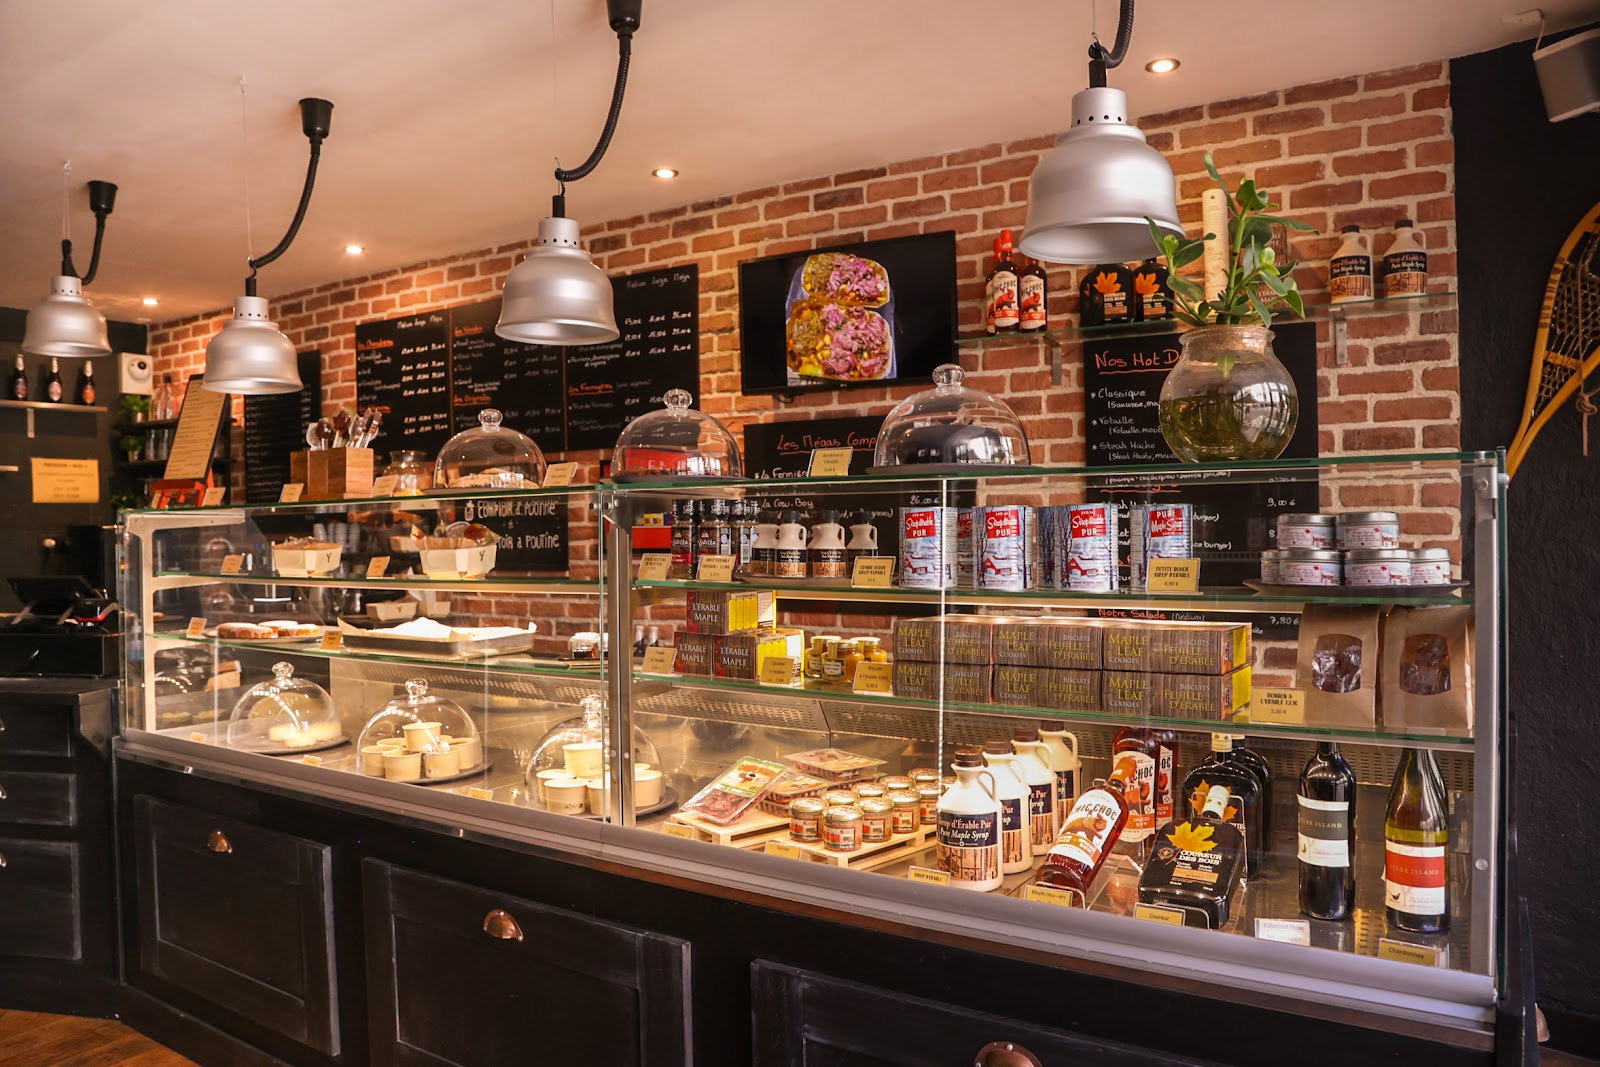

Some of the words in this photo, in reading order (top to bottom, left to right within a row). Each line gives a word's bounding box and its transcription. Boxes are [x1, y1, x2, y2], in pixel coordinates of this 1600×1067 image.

[1095, 350, 1128, 369] Nos
[1133, 352, 1160, 367] Hot
[1163, 348, 1181, 365] D
[1098, 386, 1146, 400] Classique
[1099, 416, 1135, 424] Volaille
[777, 434, 799, 450] Les
[803, 434, 841, 449] Mégas
[847, 432, 880, 447] Comp
[1100, 442, 1128, 450] Steak
[761, 469, 770, 479] La
[762, 499, 770, 508] La
[1157, 509, 1176, 518] PURE
[1193, 512, 1220, 522] burger)
[1152, 520, 1166, 532] Maple
[1082, 528, 1097, 536] PUR
[1204, 540, 1232, 550] burger)
[692, 603, 720, 612] L'ÉRABLE
[694, 614, 718, 622] MAPLE
[1098, 608, 1127, 618] Notre
[1130, 610, 1166, 620] Salade
[898, 628, 930, 638] MAPLE
[1000, 630, 1034, 641] MAPLE
[1063, 634, 1091, 642] BISCUITS
[905, 640, 927, 648] LEAF
[1109, 634, 1148, 646] MAPLE
[680, 644, 707, 652] L'ÉRABLE
[1006, 642, 1030, 652] LEAF
[1049, 640, 1084, 651] FEUILLE
[1164, 645, 1202, 656] FEUILLE
[720, 646, 749, 656] L'ÉRABLE
[1118, 646, 1144, 657] LEAF
[682, 654, 704, 663] MAPLE
[722, 658, 747, 666] MAPLE
[1109, 656, 1139, 664] COOKIES
[898, 666, 930, 676] MAPLE
[955, 670, 980, 678] BISCUITS
[904, 677, 926, 686] LEAF
[1000, 672, 1035, 683] MAPLE
[1064, 676, 1091, 685] BISCUITS
[1007, 684, 1031, 694] LEAF
[1049, 682, 1084, 694] FEUILLE
[1109, 678, 1148, 690] MAPLE
[1000, 692, 1026, 700] COOKIES
[1118, 690, 1144, 702] LEAF
[1164, 690, 1203, 701] FEUILLE
[1109, 700, 1140, 708] COOKIES
[1162, 757, 1171, 770] OC
[1133, 766, 1154, 781] CHOC
[1036, 790, 1047, 798] Pur
[1002, 806, 1014, 814] Pur
[1093, 804, 1118, 821] CHOC
[952, 818, 979, 830] d'Érable
[980, 821, 992, 829] Pur
[950, 831, 972, 840] Maple
[972, 832, 990, 841] Syrup
[1180, 850, 1222, 860] COUREUR
[1198, 857, 1220, 866] BOIS
[1411, 868, 1440, 876] ISLAND
[1388, 946, 1424, 960] Chardonnay
